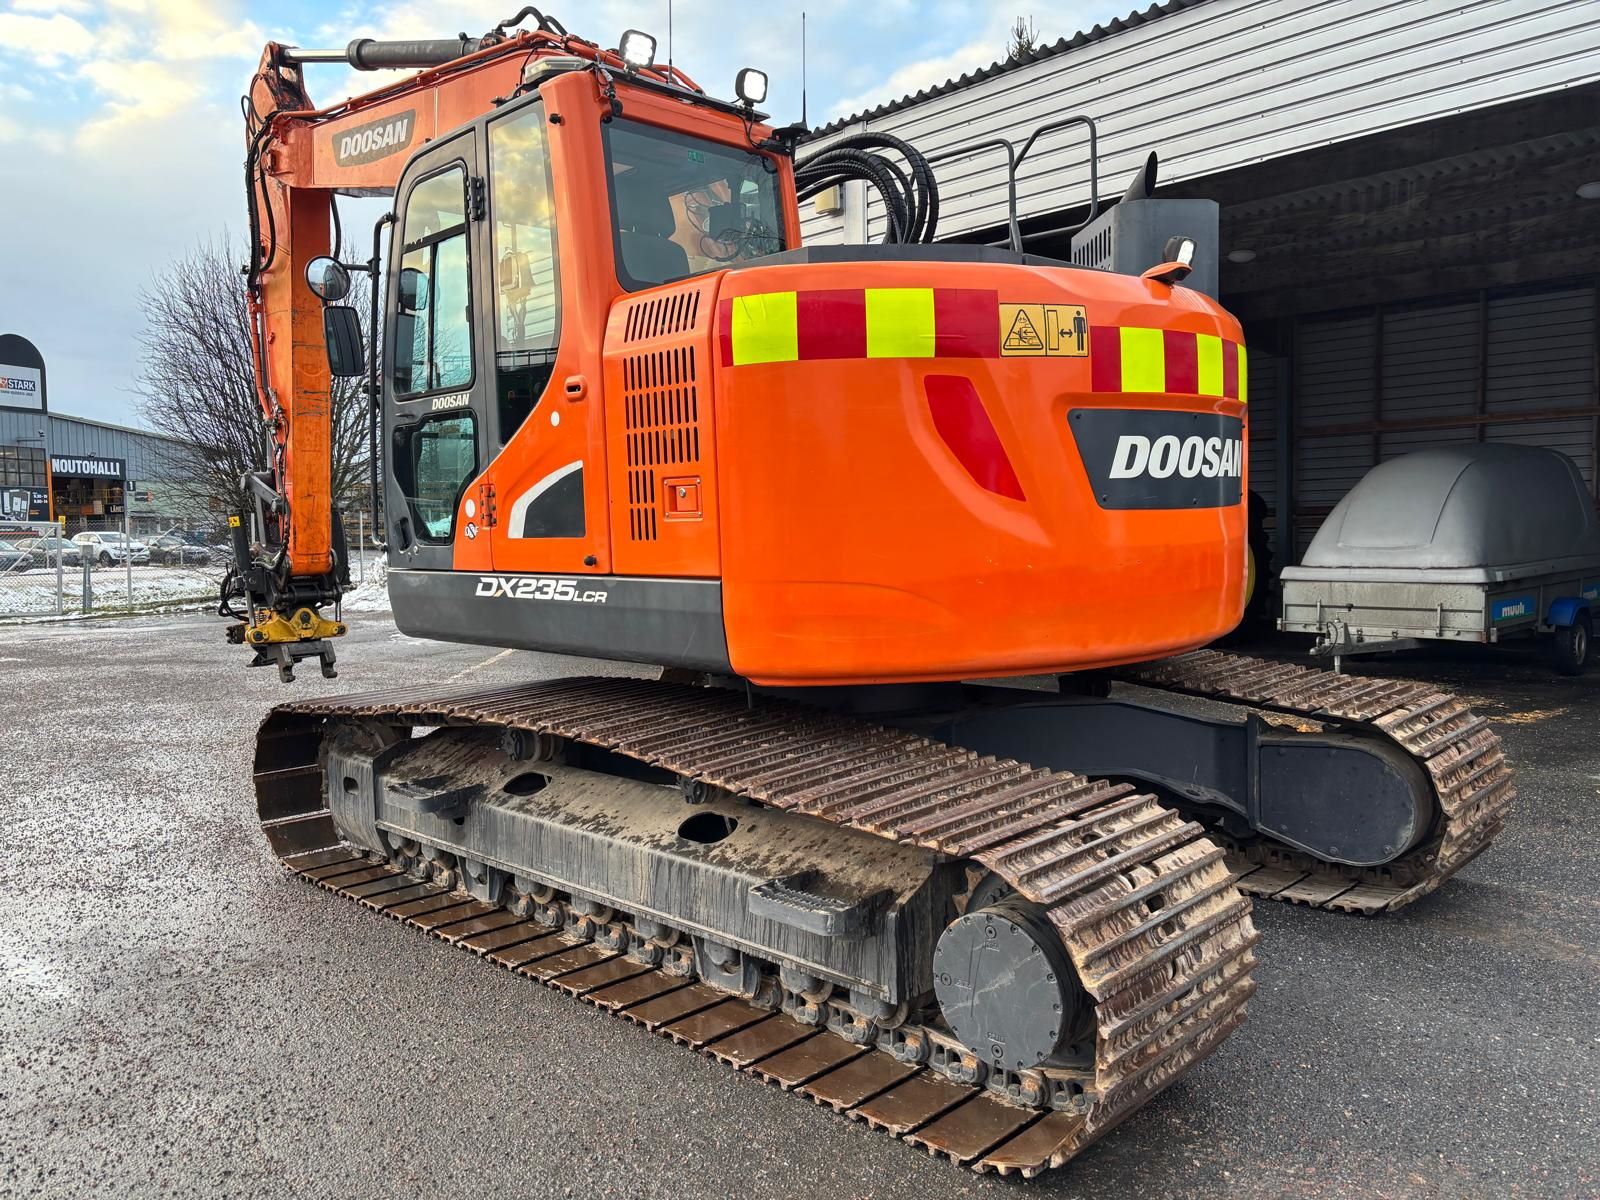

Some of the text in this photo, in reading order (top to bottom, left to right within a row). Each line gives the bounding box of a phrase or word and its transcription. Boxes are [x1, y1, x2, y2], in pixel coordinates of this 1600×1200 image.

[340, 119, 408, 159] DOOSAN
[8, 379, 35, 391] STARK
[432, 393, 470, 410] DOOSAN
[1109, 435, 1242, 479] DOOSAN
[51, 458, 120, 476] NOUTOHALLI
